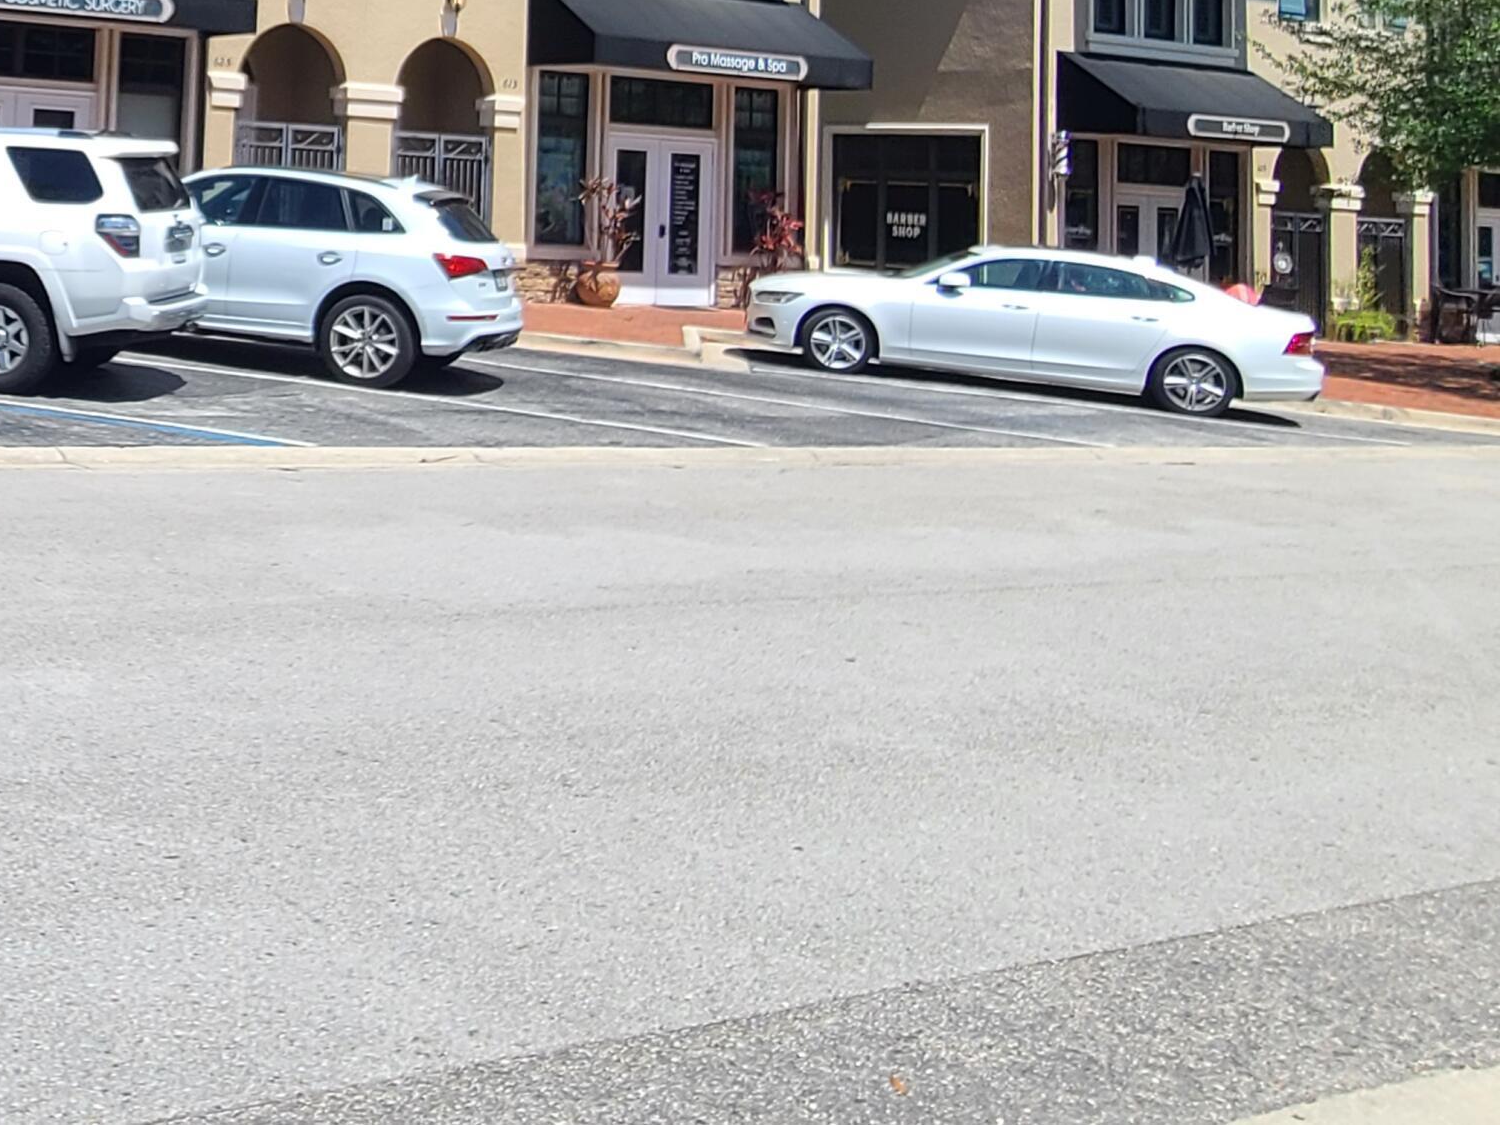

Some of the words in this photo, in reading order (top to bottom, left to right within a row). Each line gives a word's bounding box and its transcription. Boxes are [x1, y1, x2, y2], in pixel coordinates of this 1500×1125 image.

[692, 51, 709, 66] Pro
[710, 54, 755, 71] Massage
[757, 58, 766, 71] &
[767, 59, 787, 74] Spa
[886, 211, 927, 226] BARBER
[892, 225, 921, 238] SHOP
